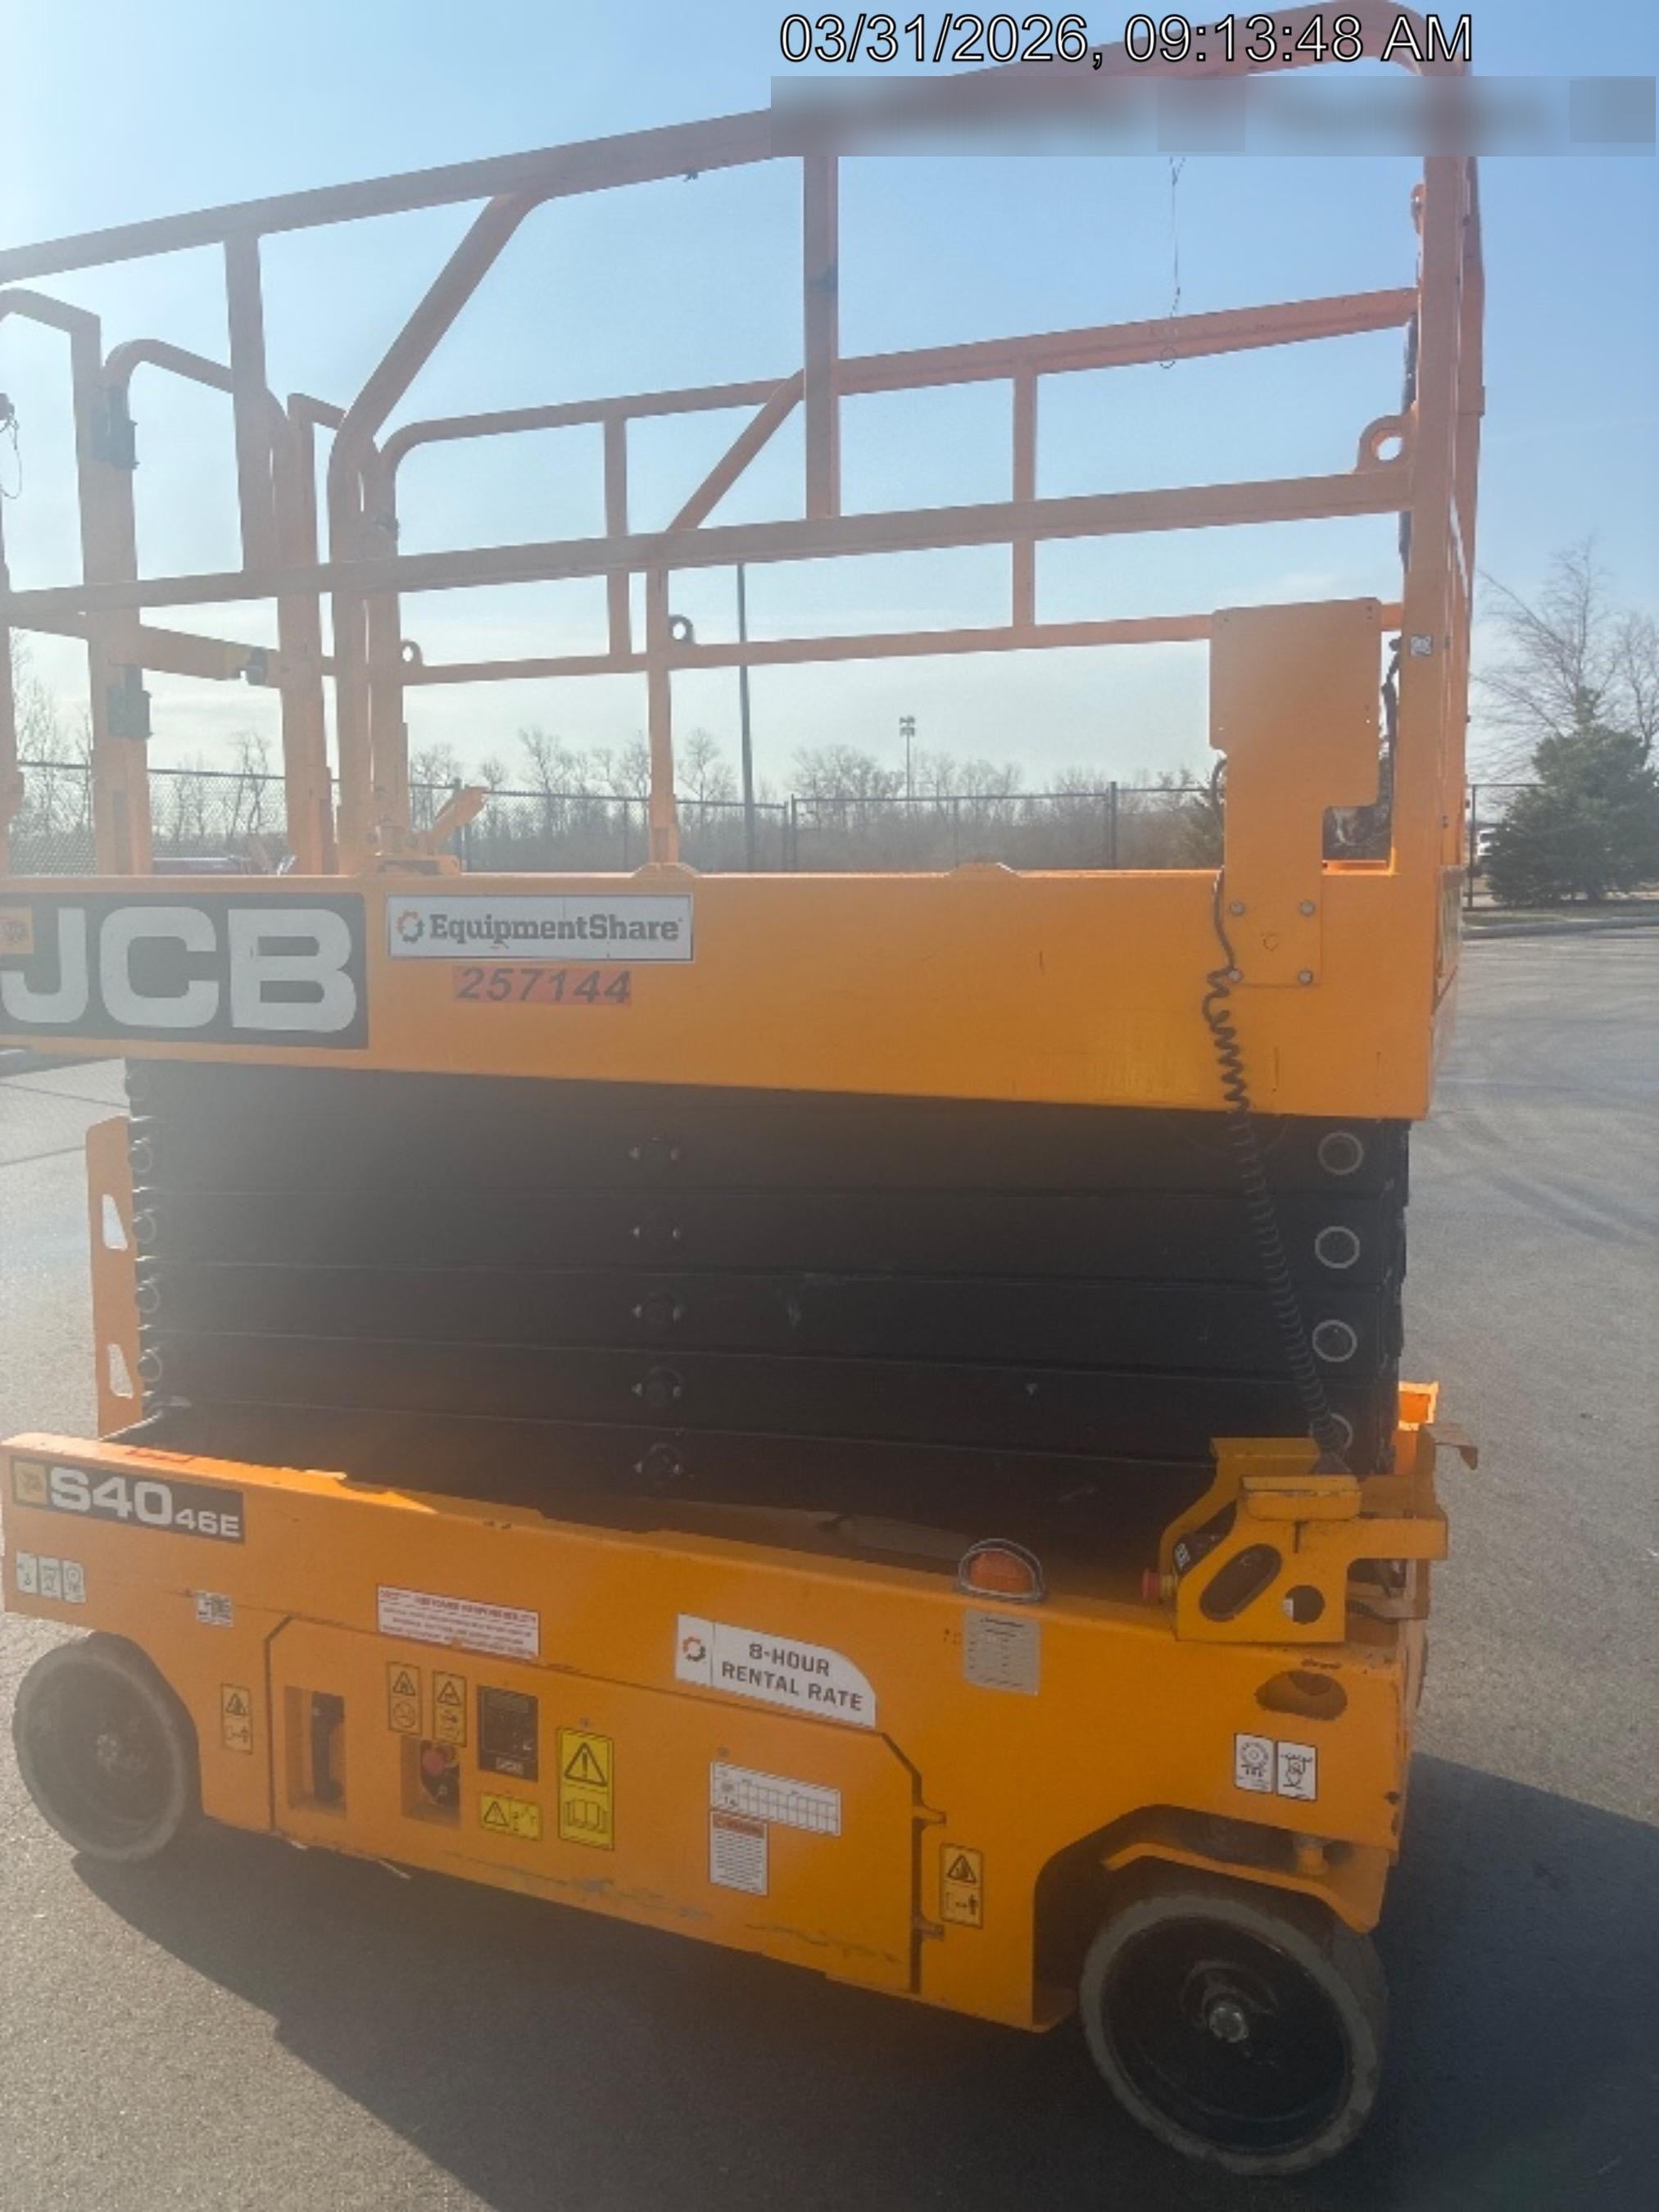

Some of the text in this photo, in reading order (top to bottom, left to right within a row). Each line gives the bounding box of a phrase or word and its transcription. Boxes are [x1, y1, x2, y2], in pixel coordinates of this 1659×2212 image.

[428, 913, 680, 944] EquipmentShare
[0, 906, 357, 1033] JCB
[456, 967, 632, 1005] 257144
[749, 1643, 829, 1677] 8-HOUR
[722, 1661, 863, 1711] RENTAL RATE
